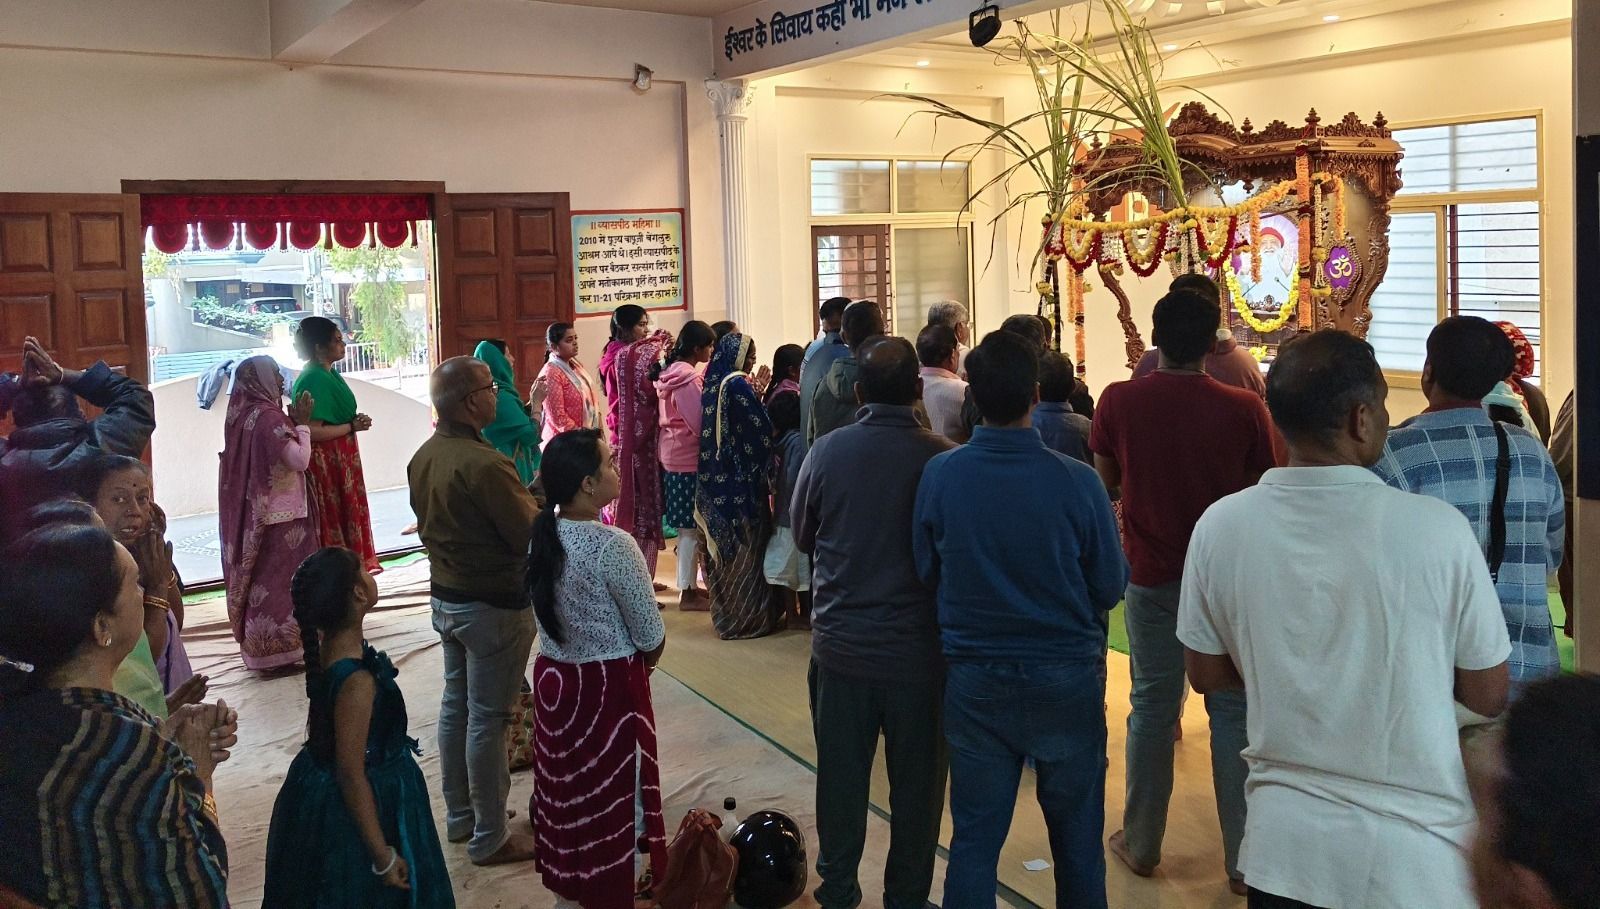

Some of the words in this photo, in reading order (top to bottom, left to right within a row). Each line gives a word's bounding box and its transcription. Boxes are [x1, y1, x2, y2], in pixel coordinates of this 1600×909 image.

[725, 26, 754, 61] ईश्वर
[755, 18, 767, 48] के
[770, 11, 813, 45] सिवाय
[632, 218, 653, 230] महिमा
[579, 237, 597, 245] 2010
[577, 250, 600, 260] आश्रम
[601, 248, 617, 259] आये
[672, 244, 680, 255] के
[599, 265, 609, 273] पर
[609, 261, 630, 273] बैठकर
[578, 294, 592, 303] कर
[642, 290, 654, 299] कर
[655, 289, 671, 299] लाभ
